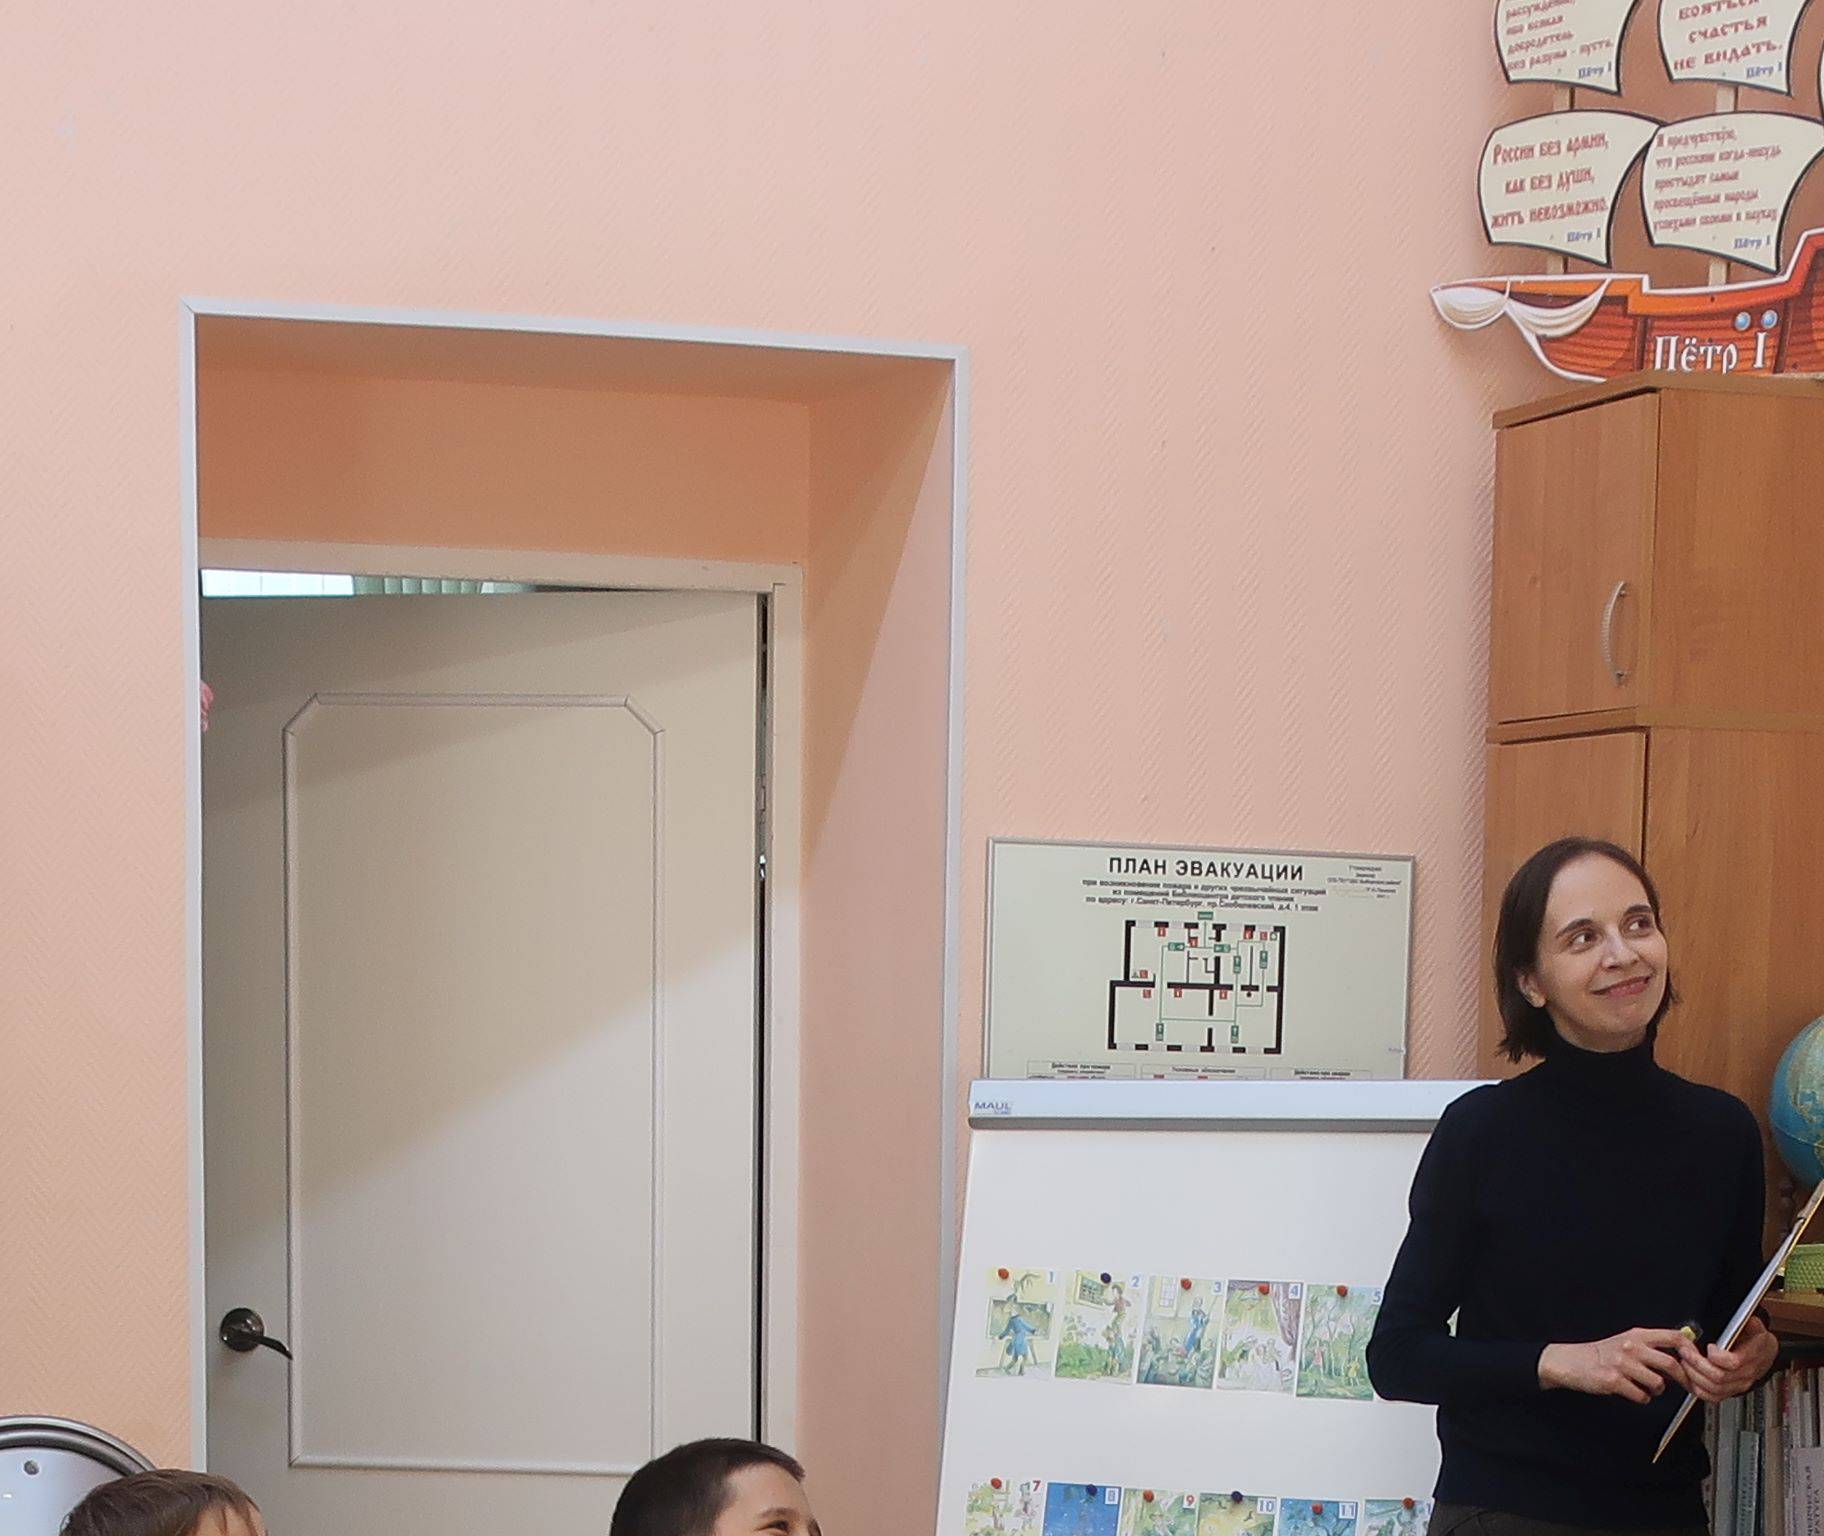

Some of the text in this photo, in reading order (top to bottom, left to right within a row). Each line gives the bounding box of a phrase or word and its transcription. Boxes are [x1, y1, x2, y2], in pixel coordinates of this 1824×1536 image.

[1653, 332, 1769, 374] Пётр I
[1108, 857, 1167, 875] ПЛАН
[1175, 860, 1304, 882] ЭВАКУАЦИИ
[1048, 1271, 1054, 1285] 1
[1130, 1275, 1140, 1288] 2
[1213, 1280, 1223, 1294] 3
[1289, 1284, 1300, 1299] 4
[1031, 1479, 1041, 1493] 7
[1106, 1489, 1116, 1504] 8
[1185, 1494, 1195, 1508] 9
[1258, 1498, 1275, 1513] 10
[1340, 1503, 1355, 1518] 11
